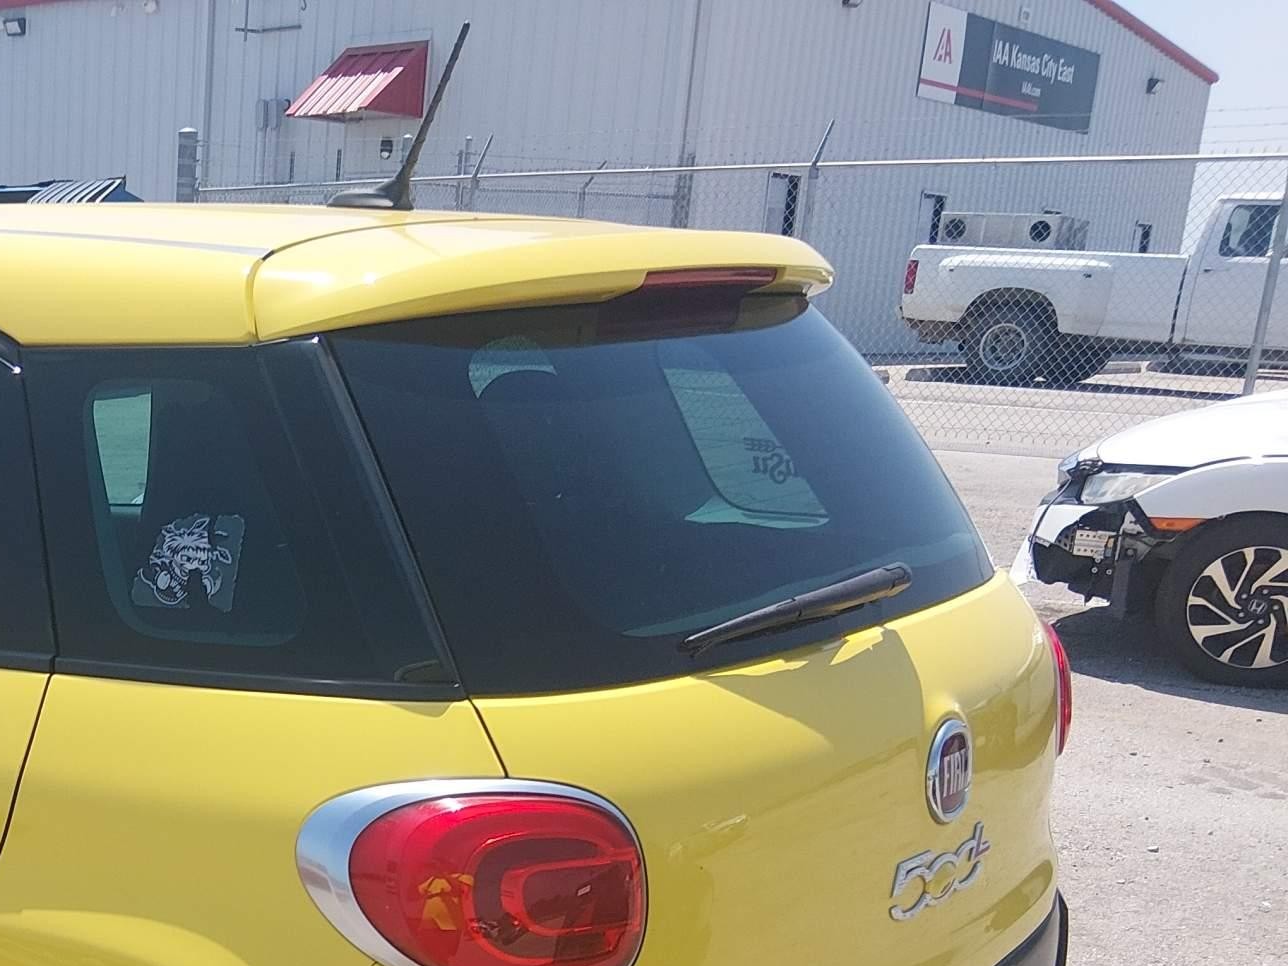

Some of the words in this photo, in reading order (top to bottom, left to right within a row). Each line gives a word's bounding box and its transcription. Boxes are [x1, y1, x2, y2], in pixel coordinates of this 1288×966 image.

[992, 39, 1010, 66] IAA
[1010, 43, 1041, 74] Kansas
[1041, 53, 1058, 85] City
[1057, 58, 1075, 84] East
[943, 748, 971, 798] FIAT
